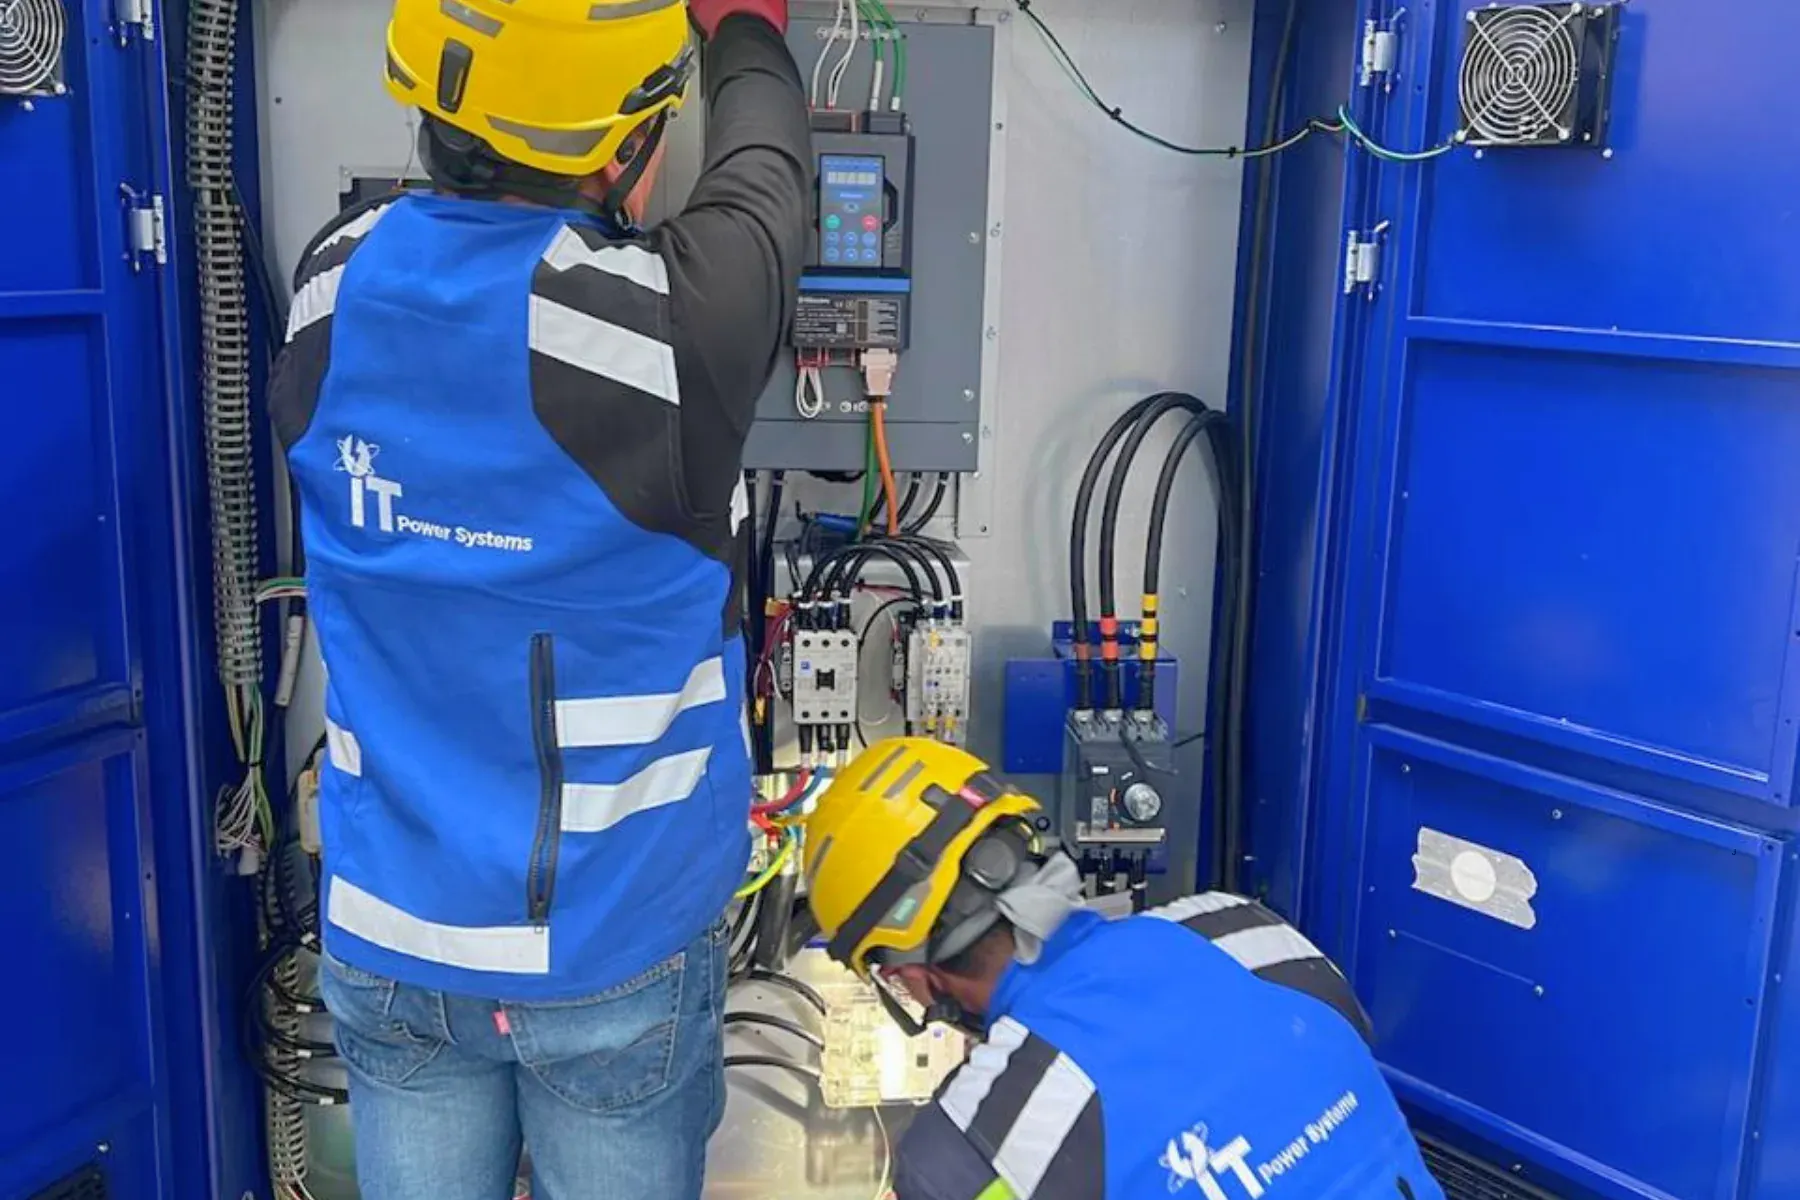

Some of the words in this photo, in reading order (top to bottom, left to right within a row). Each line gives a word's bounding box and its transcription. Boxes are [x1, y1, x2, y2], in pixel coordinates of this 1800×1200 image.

[397, 515, 451, 540] Power
[454, 527, 533, 551] Systems
[1257, 1136, 1311, 1185] Power
